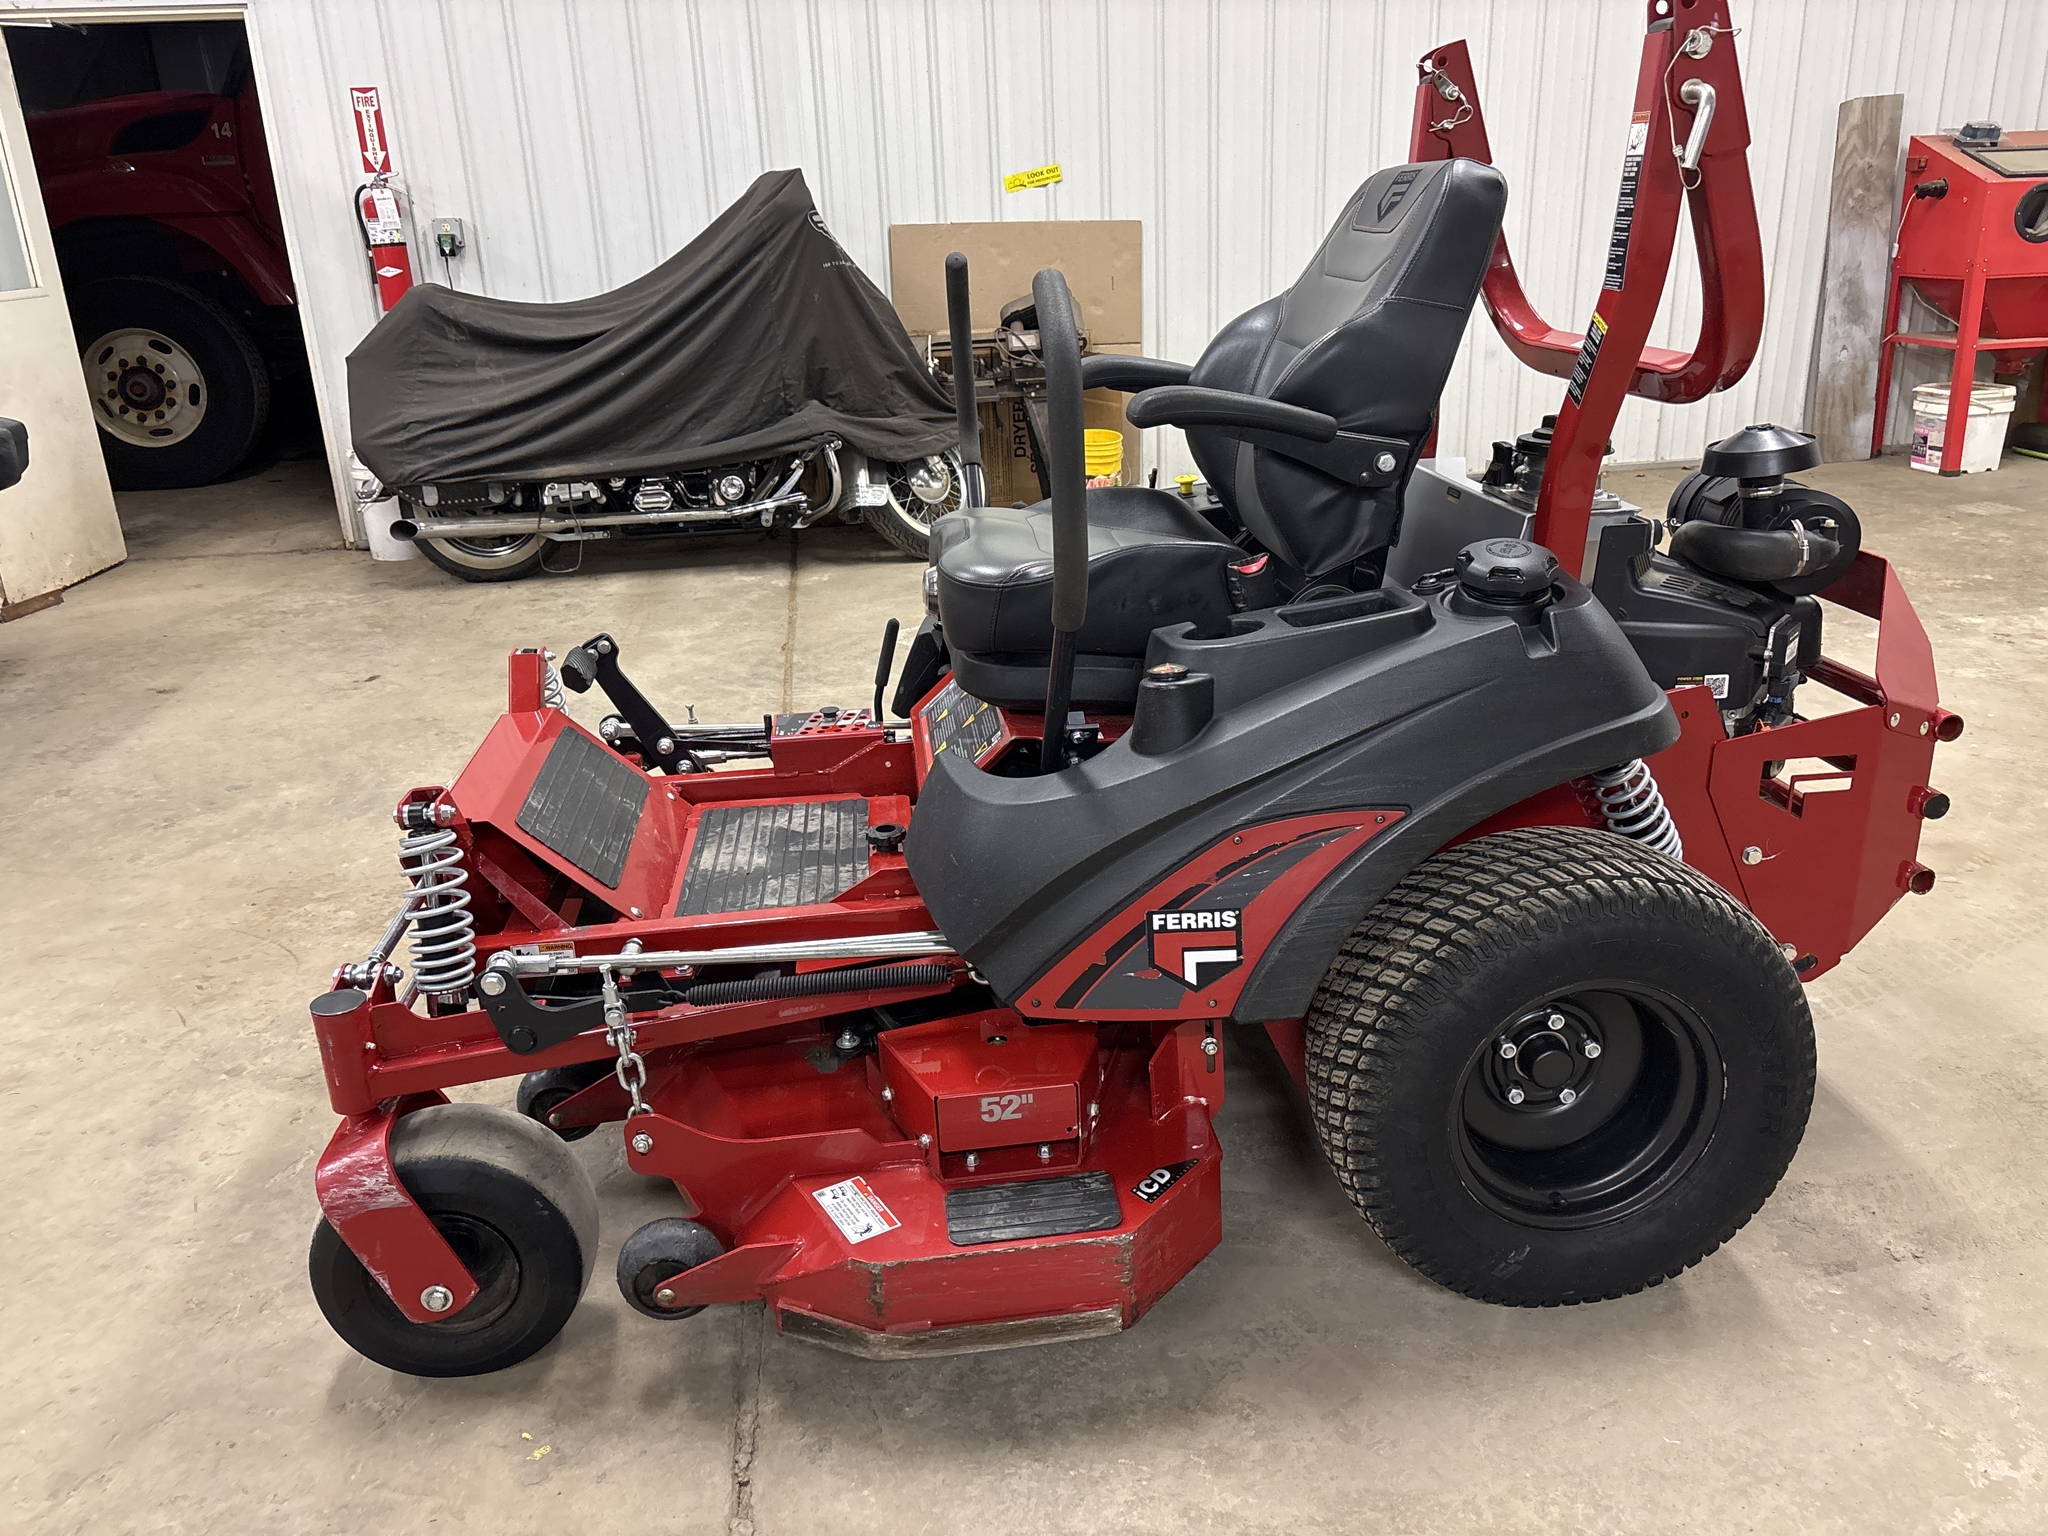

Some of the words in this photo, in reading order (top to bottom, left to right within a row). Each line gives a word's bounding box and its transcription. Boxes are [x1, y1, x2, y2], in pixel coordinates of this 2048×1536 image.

[356, 95, 375, 107] FIRE
[211, 121, 233, 139] 14
[365, 109, 379, 165] EXTINGUISHER
[1027, 171, 1045, 180] LOOK
[1046, 166, 1059, 175] OUT
[1152, 910, 1237, 931] FERRIS
[980, 1093, 1034, 1123] 52"
[1132, 1168, 1171, 1200] iCD
[867, 1194, 885, 1213] DANGER
